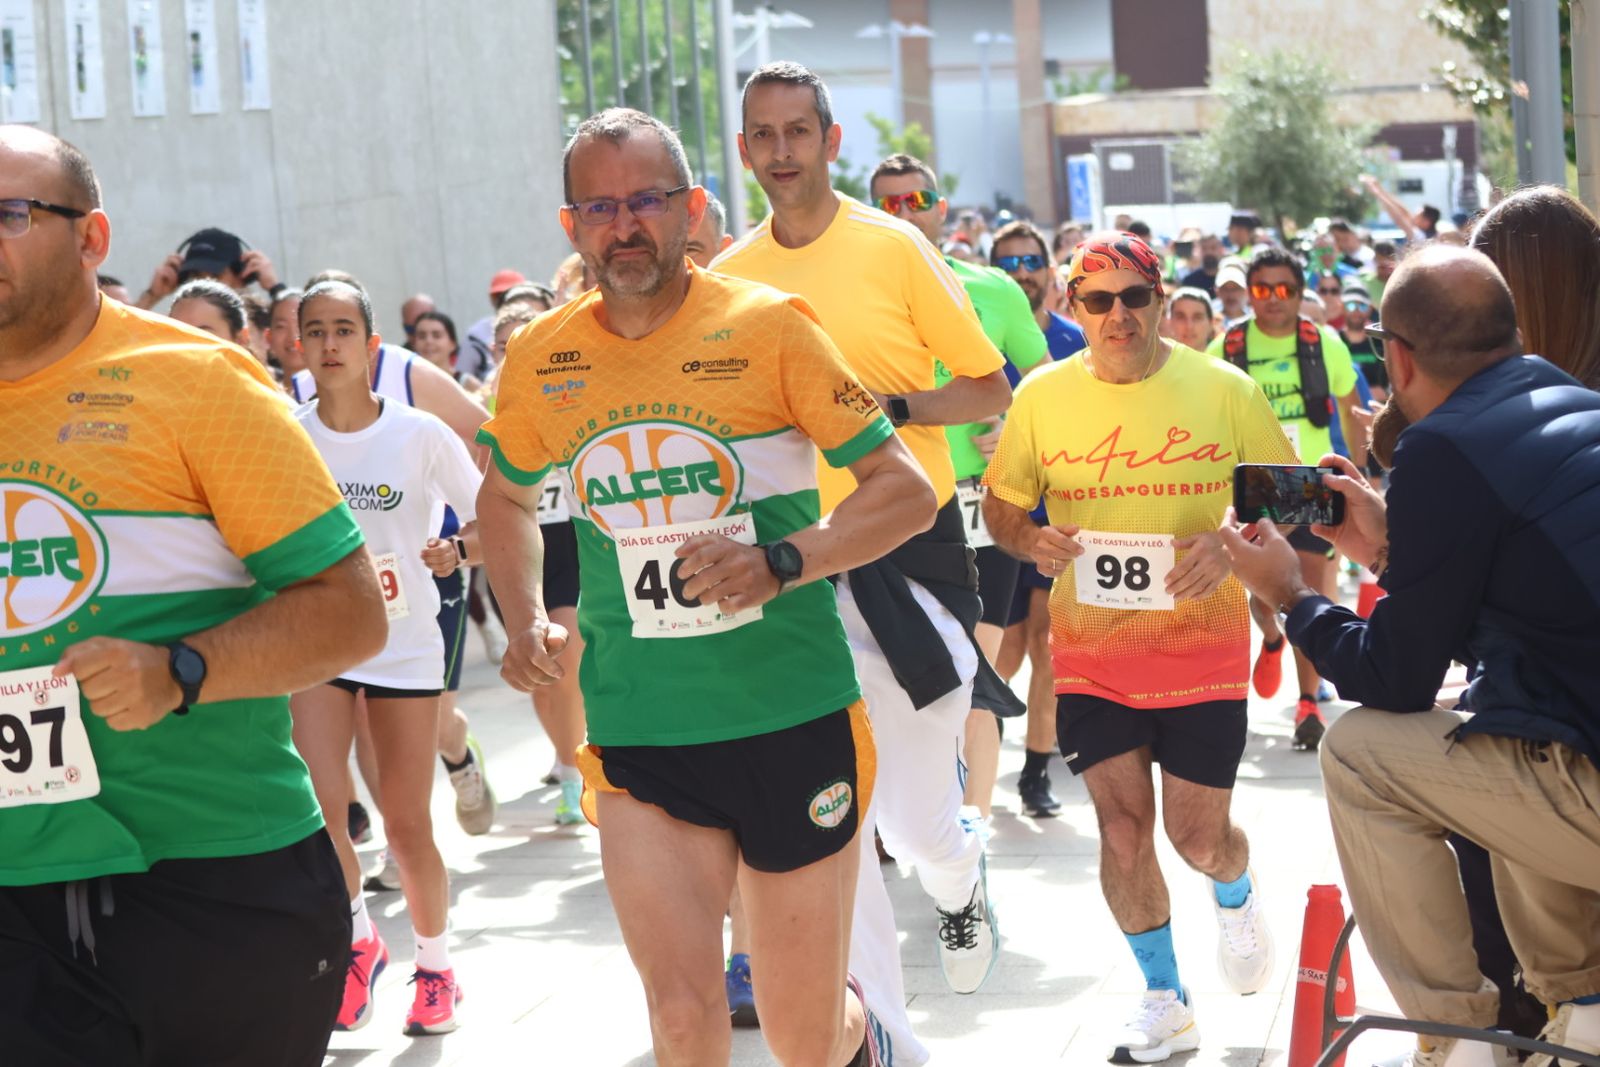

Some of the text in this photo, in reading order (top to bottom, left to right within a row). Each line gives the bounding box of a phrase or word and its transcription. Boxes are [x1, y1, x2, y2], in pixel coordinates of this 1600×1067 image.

[536, 364, 592, 376] Helmántica
[682, 357, 749, 373] ce consulting
[563, 403, 732, 459] CLUB DEPORTIVO
[0, 460, 98, 506] ORTIVO
[586, 460, 725, 507] ALCER
[345, 497, 383, 511] COM
[964, 499, 978, 530] 7
[621, 536, 639, 547] DÍA
[640, 535, 654, 545] DE
[1104, 538, 1139, 547] CASTILLA
[1147, 539, 1166, 548] LEÓ
[379, 570, 398, 601] 9
[1096, 554, 1151, 591] 98
[26, 682, 34, 692] Y
[0, 706, 66, 773] 97
